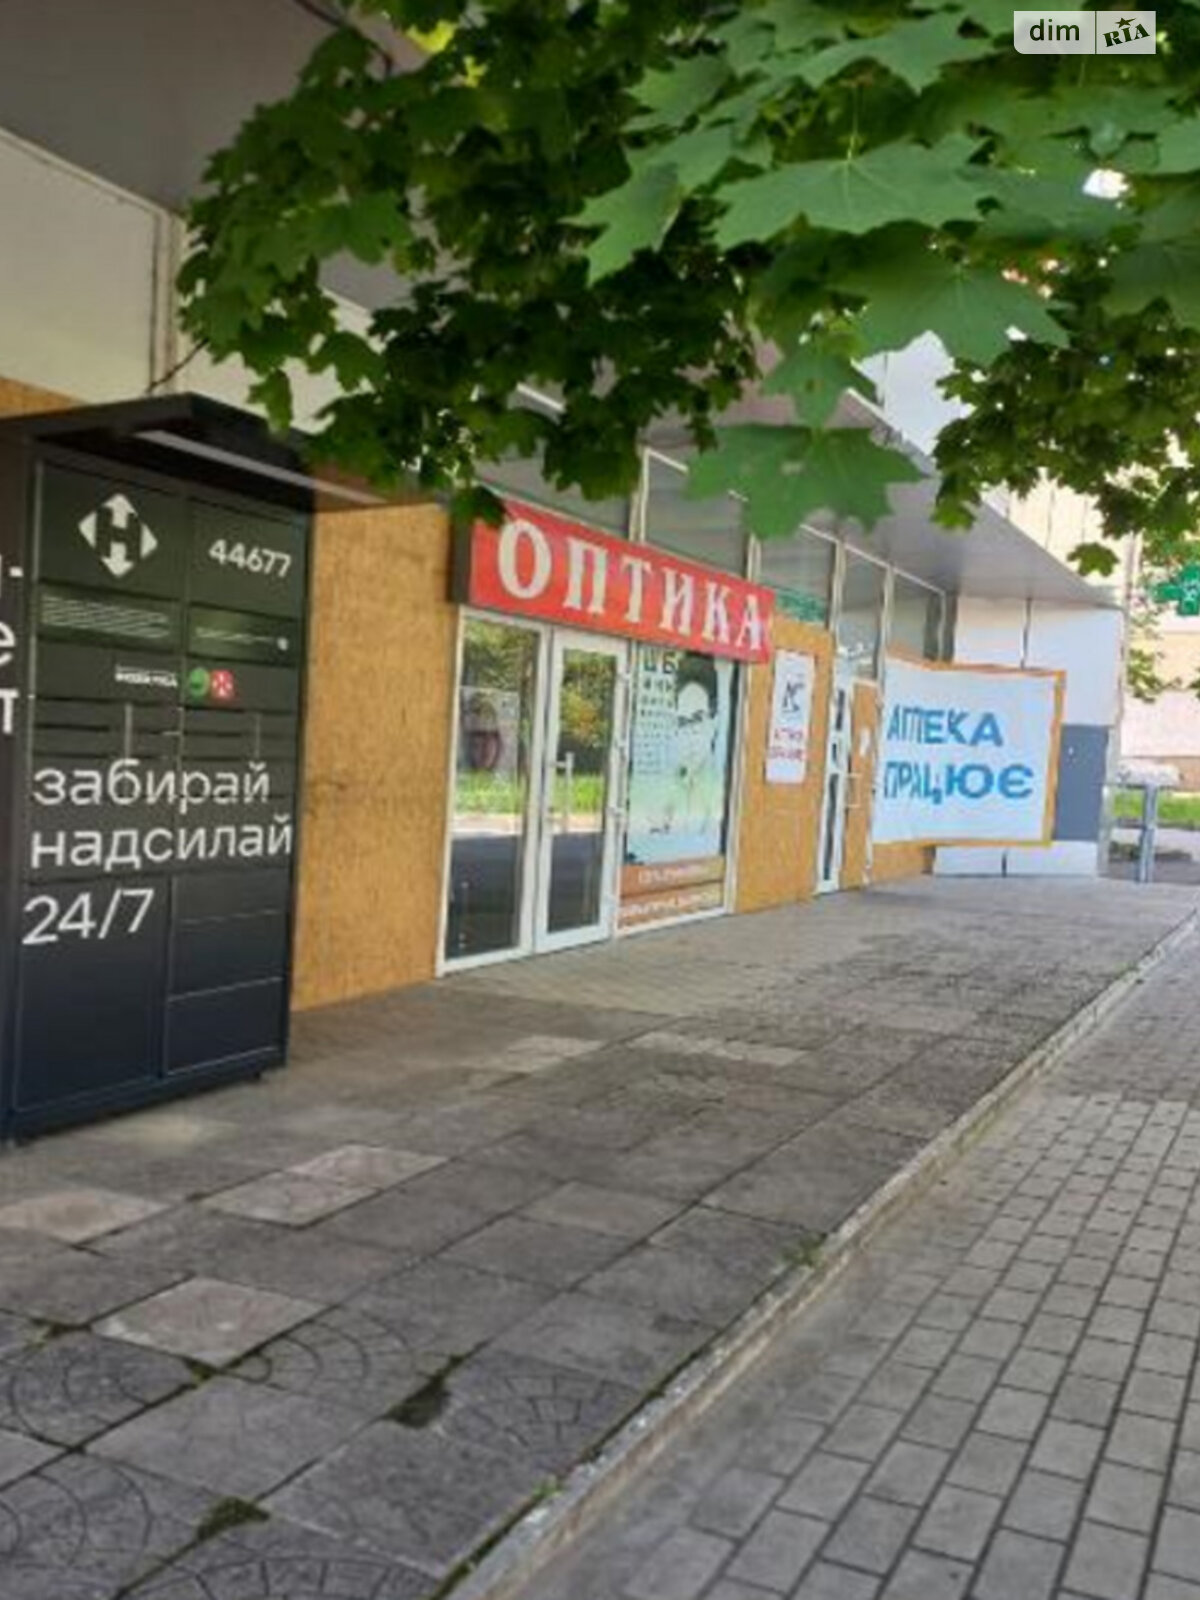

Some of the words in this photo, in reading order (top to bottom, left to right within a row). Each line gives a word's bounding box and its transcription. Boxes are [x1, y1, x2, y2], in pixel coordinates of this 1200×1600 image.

[208, 538, 292, 578] 44677
[497, 518, 762, 651] ОПТИКА
[33, 758, 270, 814] забирай
[884, 760, 1035, 805] ПРАЦЮЄ
[30, 814, 292, 871] надсилай
[22, 888, 155, 945] 24/7
